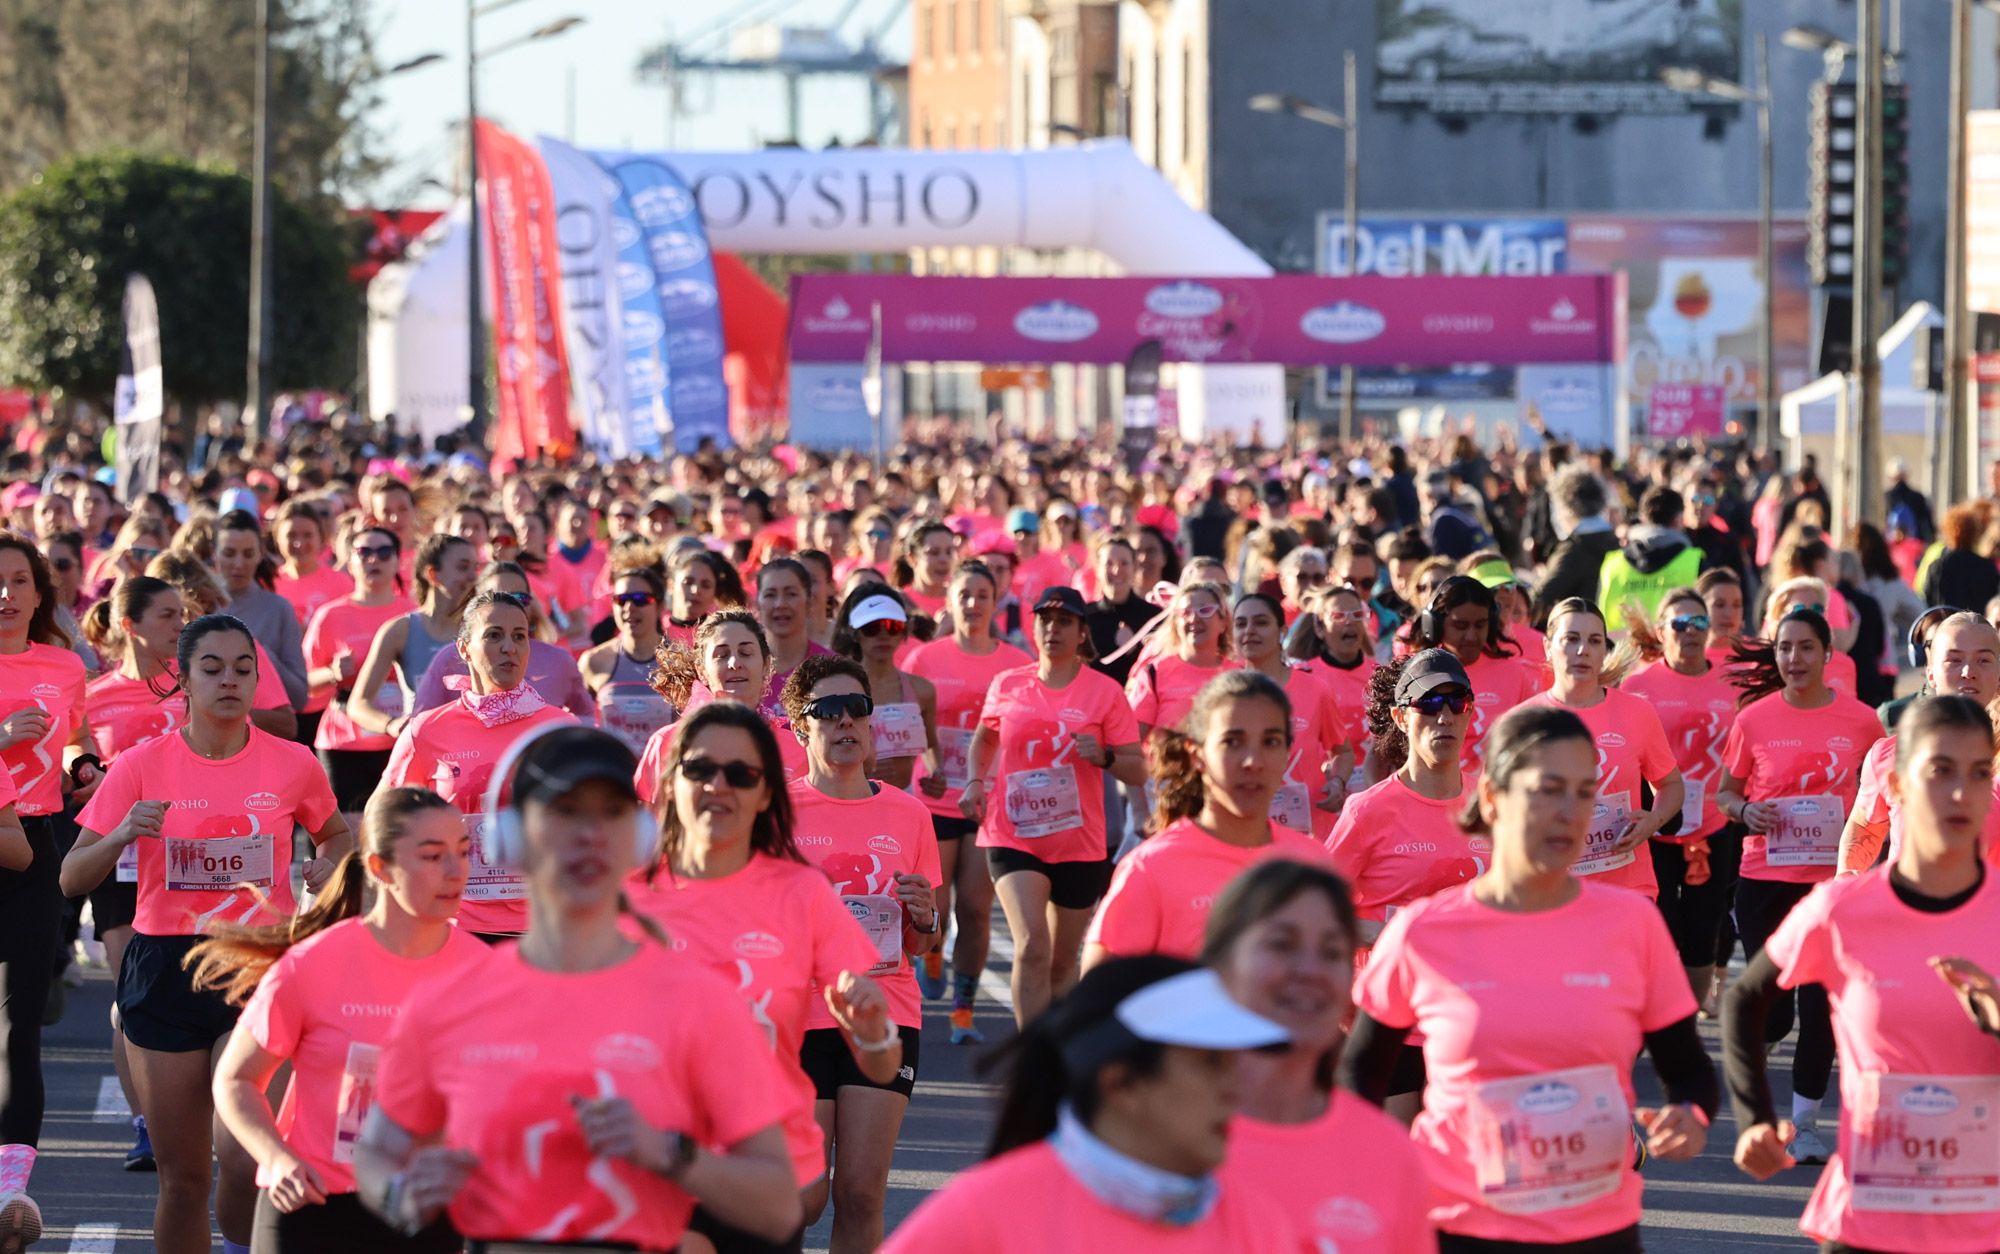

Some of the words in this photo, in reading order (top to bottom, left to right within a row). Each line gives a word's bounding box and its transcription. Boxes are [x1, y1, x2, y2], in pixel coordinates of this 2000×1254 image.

[694, 166, 981, 230] OYSHO
[1327, 222, 1426, 277] Del
[1441, 222, 1566, 277] Mar
[886, 730, 912, 742] 016
[442, 751, 480, 762] OYSHO
[1029, 797, 1057, 811] 016
[1585, 829, 1615, 845] 016
[1792, 826, 1823, 839] 016
[1394, 842, 1437, 855] OYSHO
[203, 855, 243, 872] 016
[212, 875, 231, 883] 5668
[1530, 1132, 1586, 1160] 016
[1903, 1137, 1959, 1160] 016
